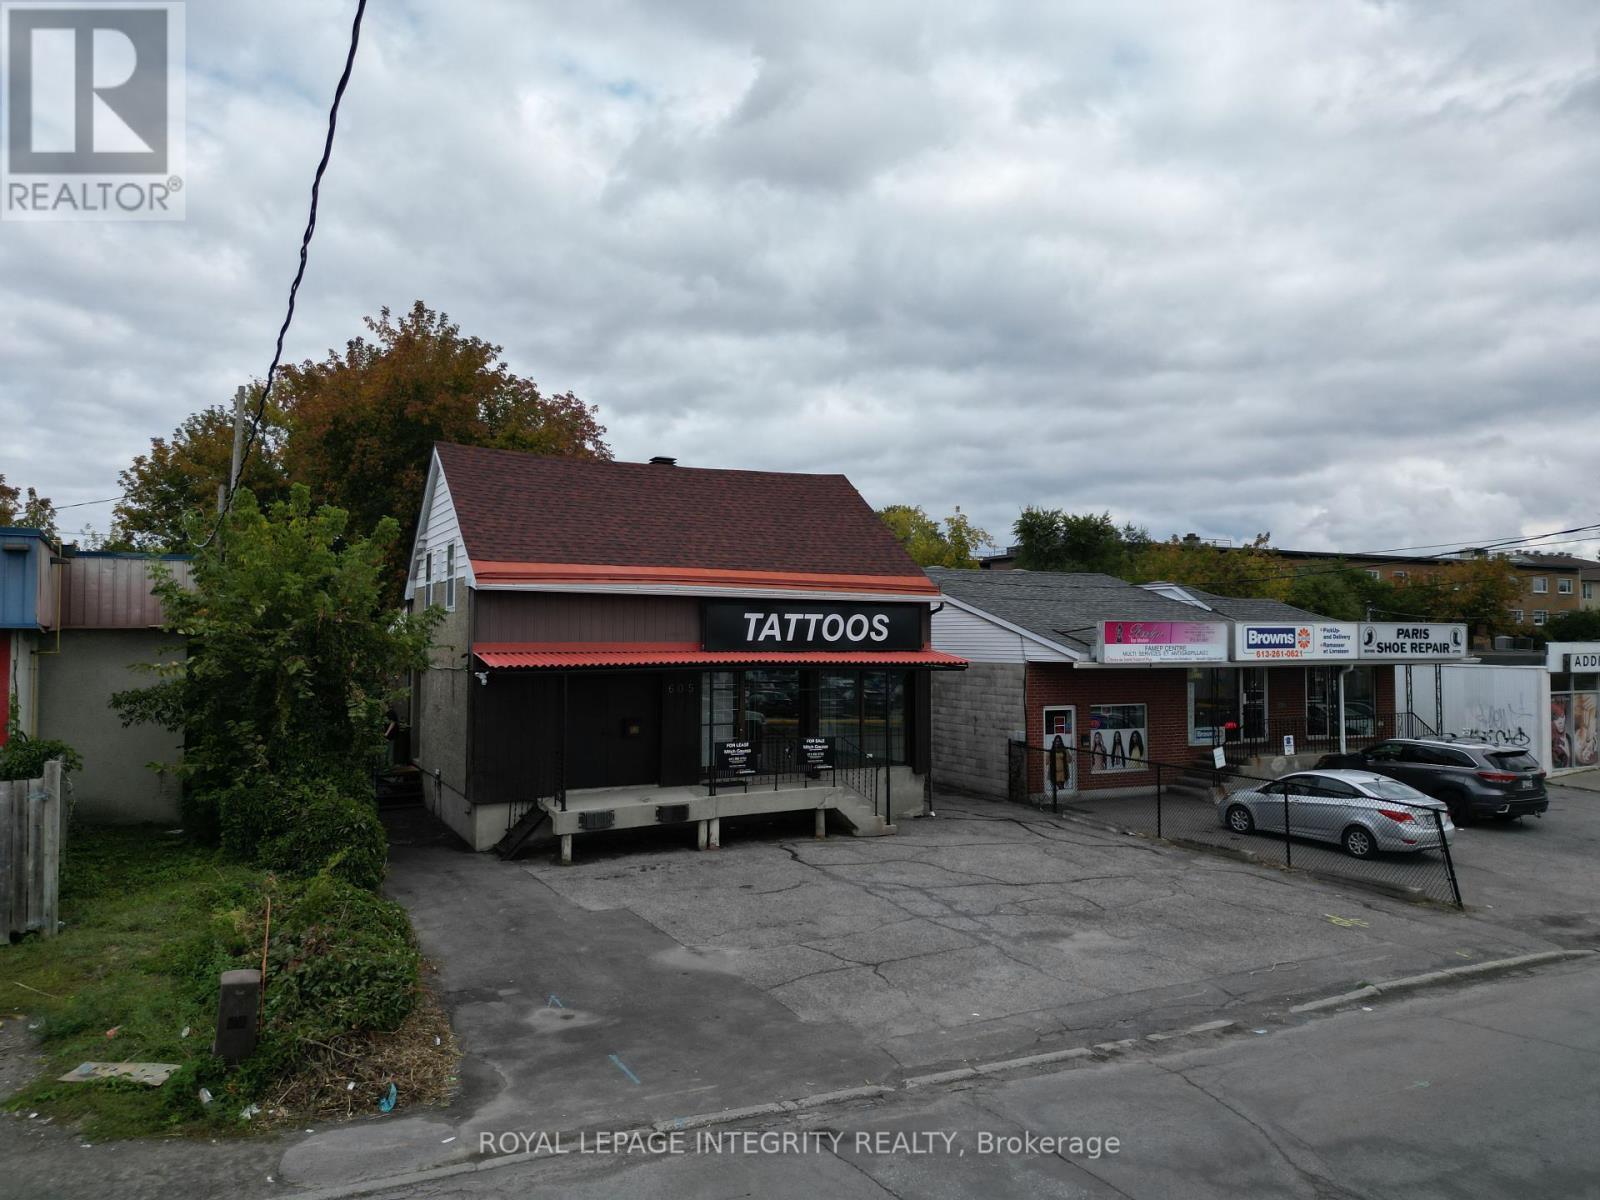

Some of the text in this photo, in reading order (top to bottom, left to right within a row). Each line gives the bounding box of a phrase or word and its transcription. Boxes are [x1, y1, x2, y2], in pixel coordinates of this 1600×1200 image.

[744, 612, 890, 642] TATTOOS
[1248, 630, 1295, 645] Browns
[1396, 628, 1430, 640] PARIS
[1376, 642, 1408, 653] SHOE
[1410, 642, 1450, 653] REPAIR
[1574, 655, 1600, 668] ADD
[668, 682, 695, 694] 605
